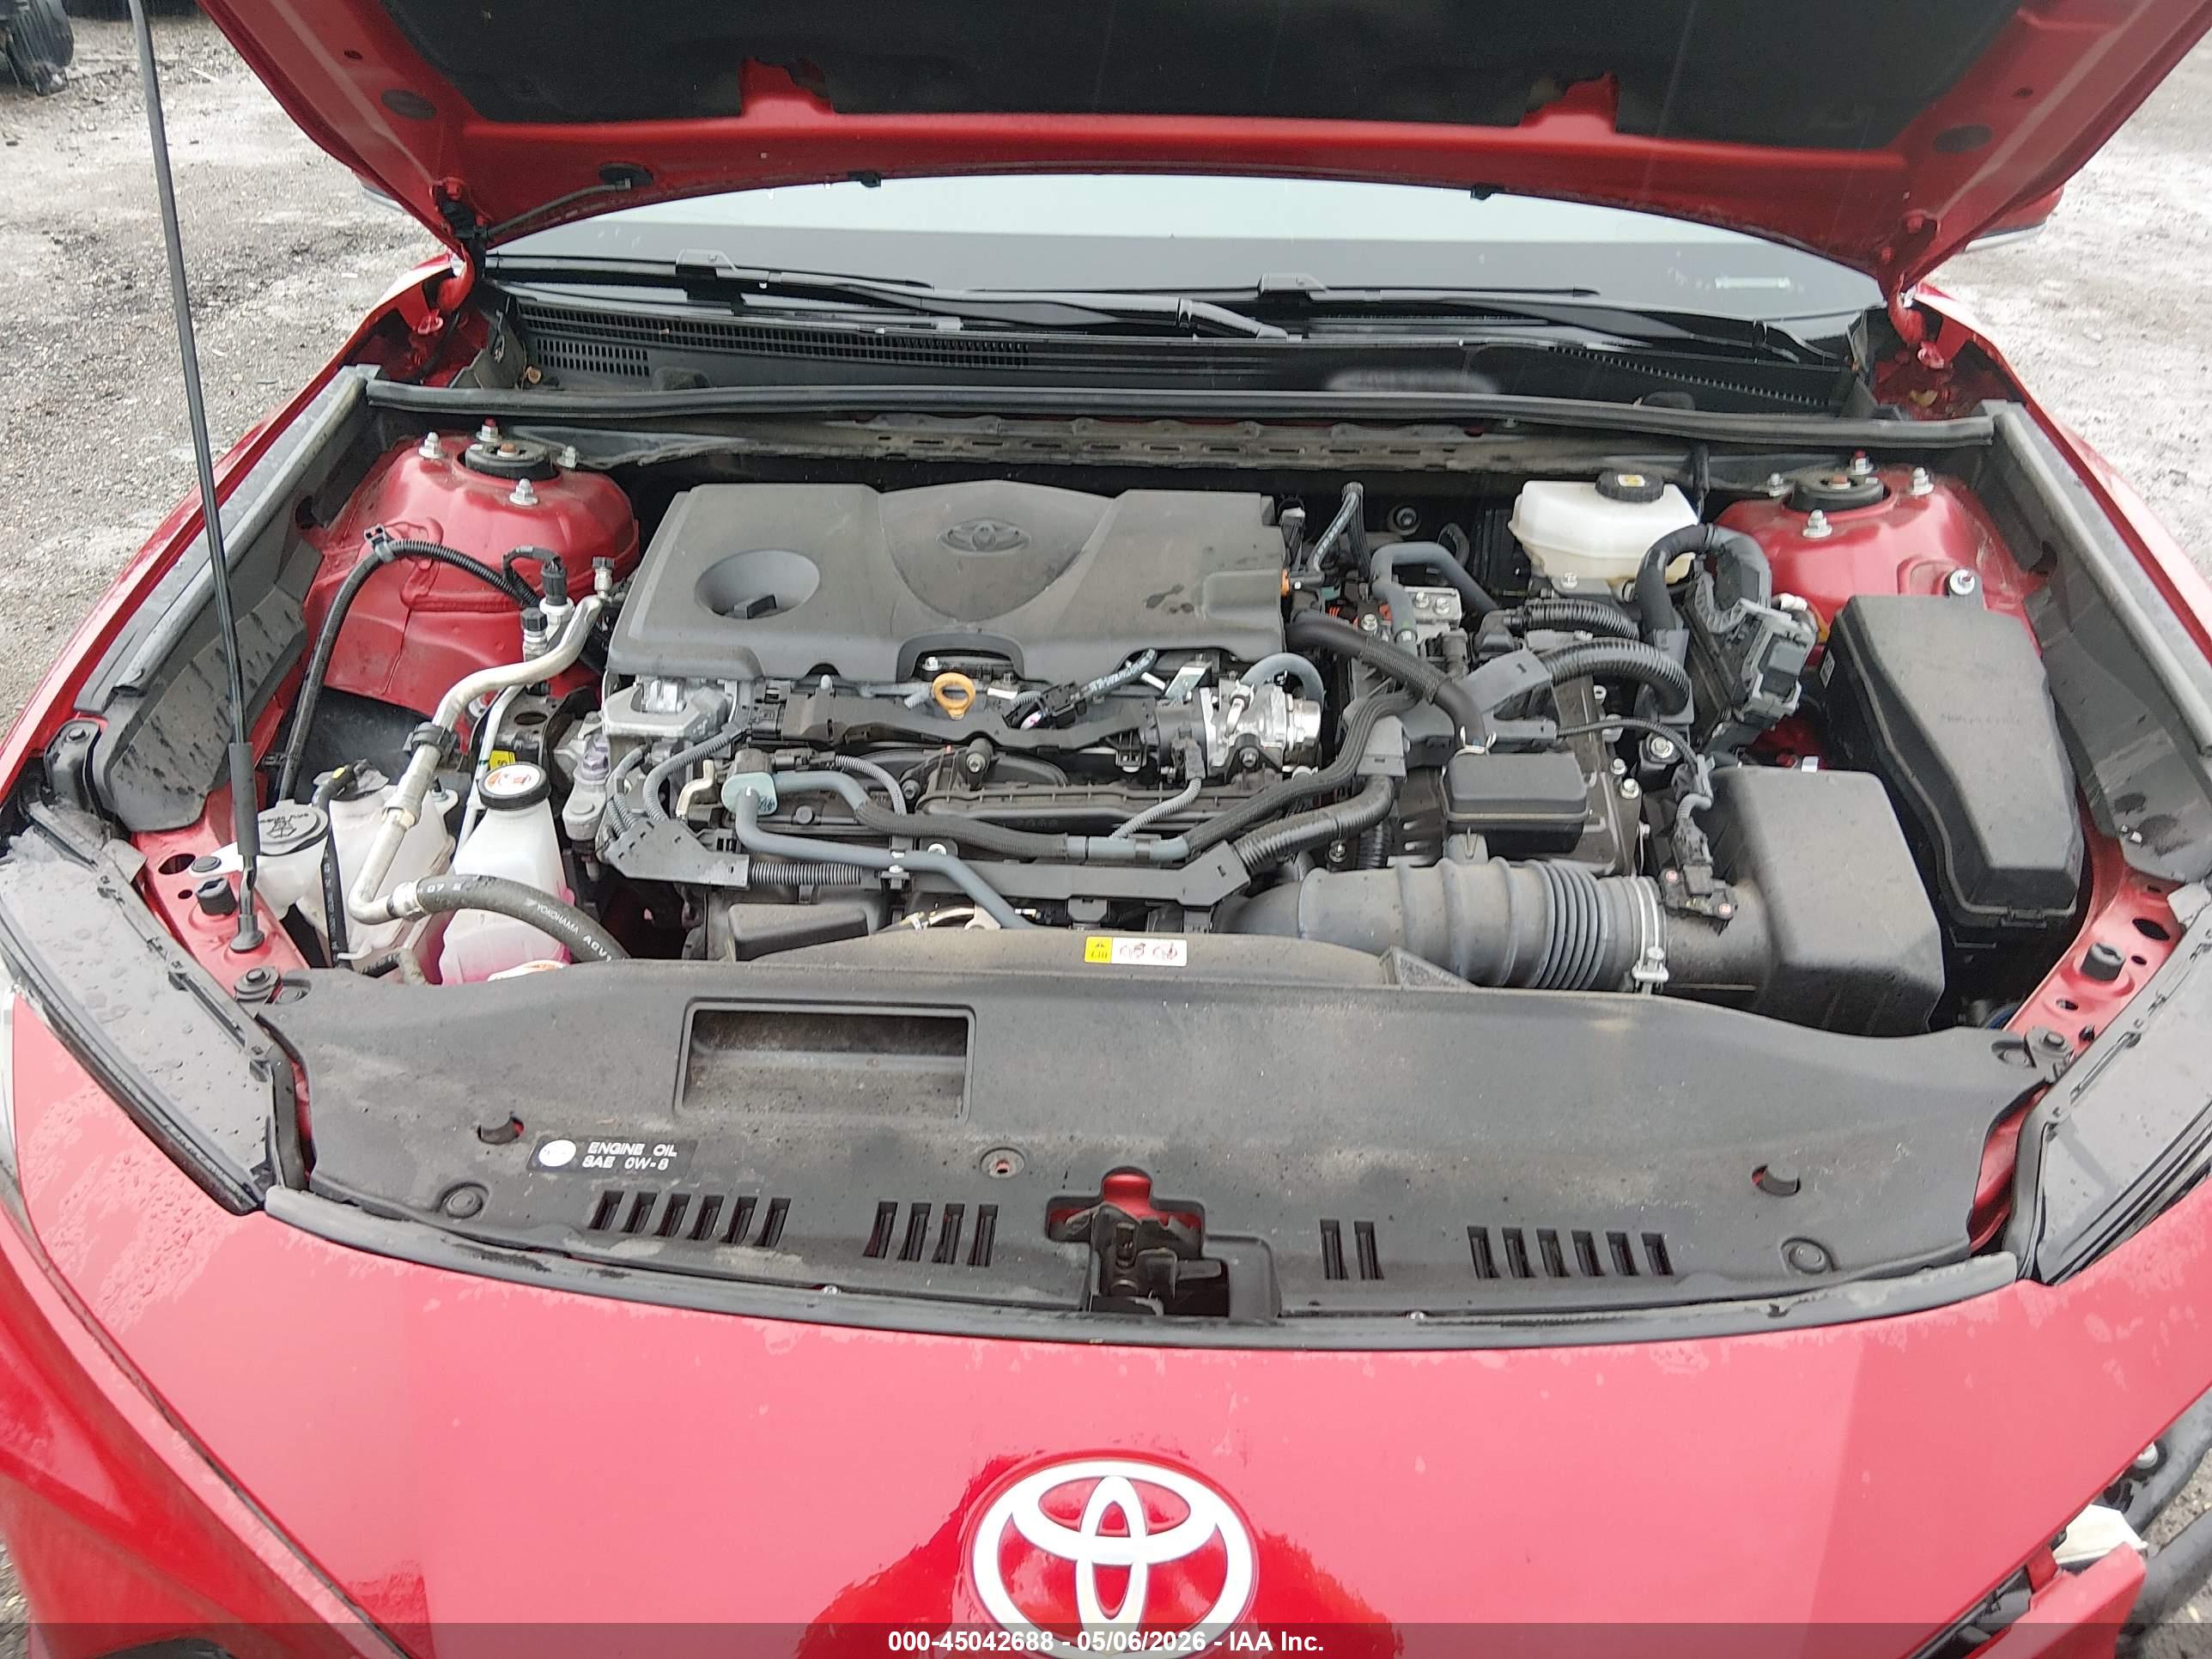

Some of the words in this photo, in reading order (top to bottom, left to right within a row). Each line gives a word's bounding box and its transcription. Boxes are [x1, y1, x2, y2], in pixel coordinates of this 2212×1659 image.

[538, 902, 579, 935] YOKOHAMA
[587, 1141, 646, 1156] ENGINE
[653, 1143, 678, 1158] OIL
[582, 1155, 616, 1169] SAE
[624, 1156, 670, 1171] 0W-8
